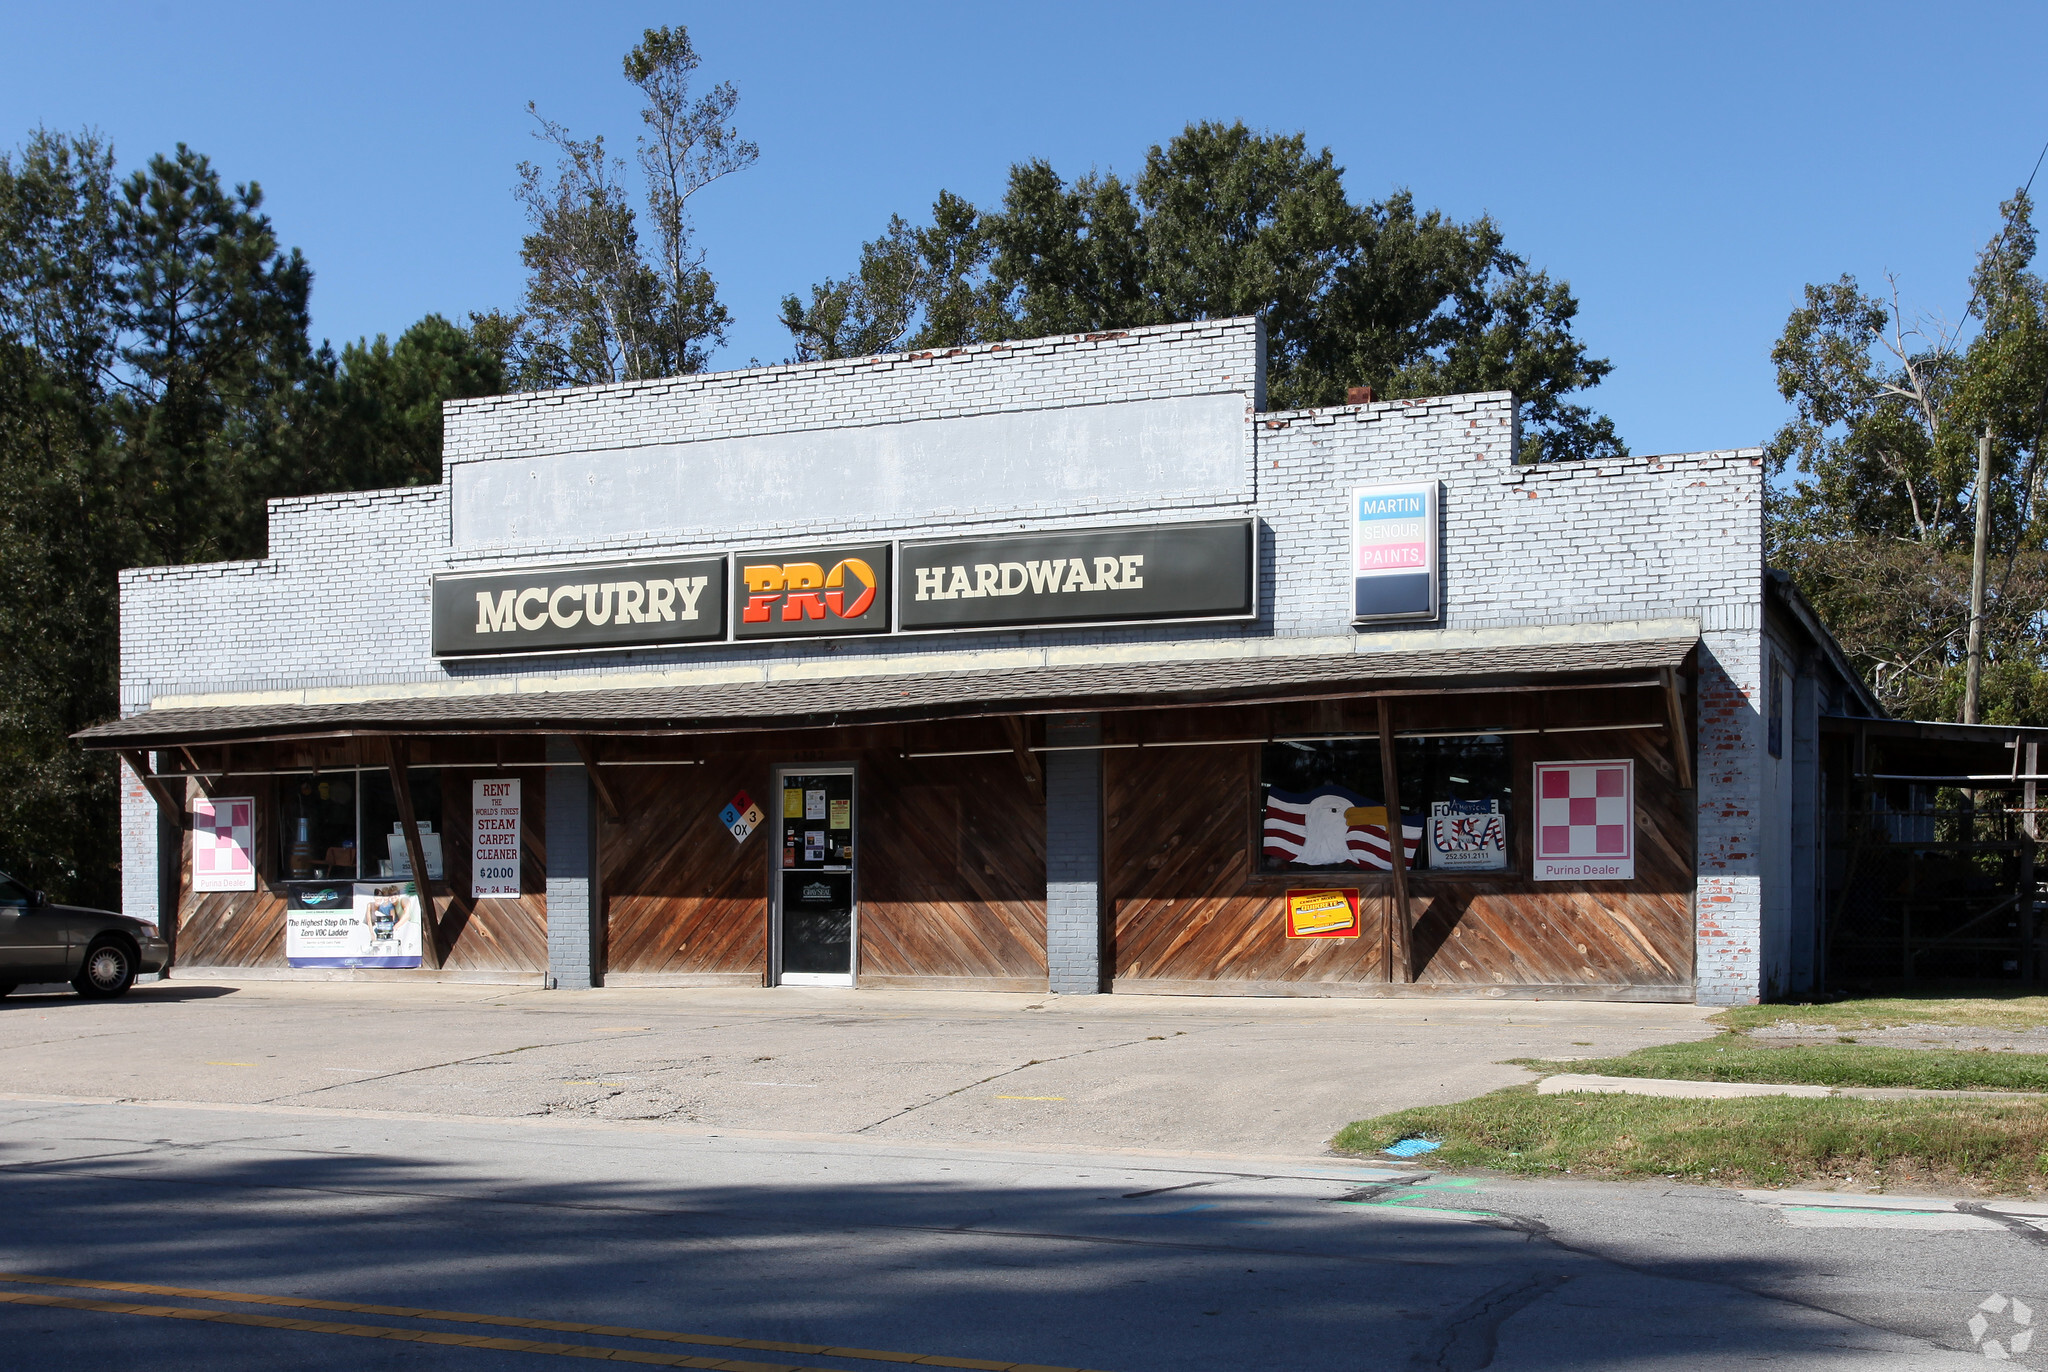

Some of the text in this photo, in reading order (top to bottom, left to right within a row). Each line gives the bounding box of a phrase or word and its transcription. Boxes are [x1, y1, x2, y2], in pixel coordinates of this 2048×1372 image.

[1364, 497, 1420, 515] MARTIN
[1364, 523, 1419, 540] SENOUR
[1364, 547, 1419, 564] PAINTS
[476, 554, 1144, 633] MCCURRY PRO HARDWARE
[483, 784, 511, 797] RENT
[737, 797, 745, 808] 4
[475, 807, 520, 816] WORLD'S FINEST
[726, 811, 757, 823] 3 3
[478, 819, 516, 830] STEAM
[734, 824, 748, 836] OX
[478, 834, 516, 845] CARPET
[1434, 817, 1505, 853] USA
[476, 849, 518, 860] CLEANER
[480, 867, 514, 878] $20.00
[1546, 865, 1620, 875] Purina Dealer
[201, 879, 246, 888] Purina Dealer
[288, 918, 360, 928] The Highest Step On The
[300, 929, 349, 937] Zero VOC Ladder
